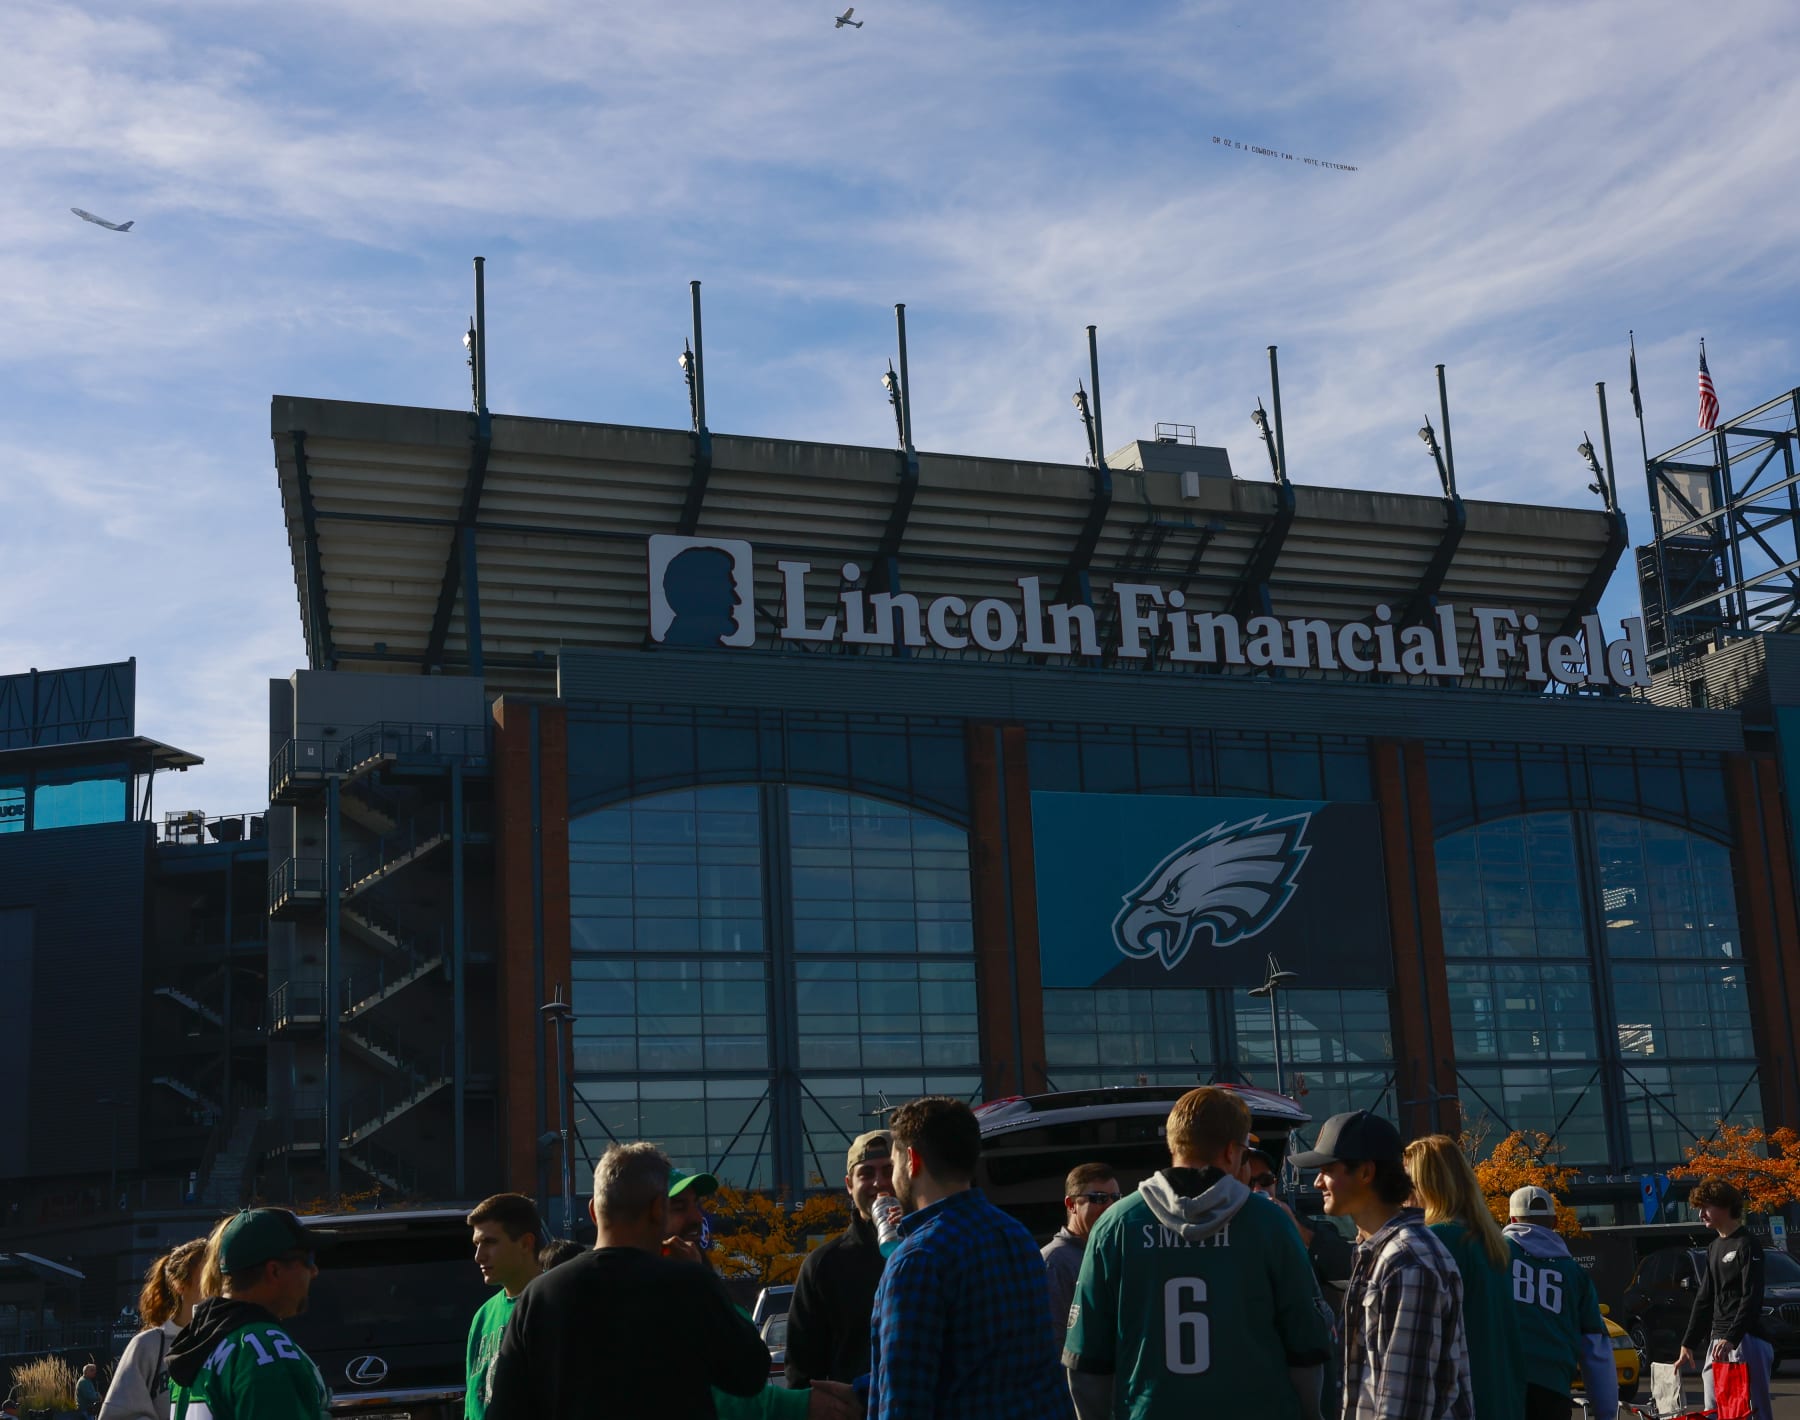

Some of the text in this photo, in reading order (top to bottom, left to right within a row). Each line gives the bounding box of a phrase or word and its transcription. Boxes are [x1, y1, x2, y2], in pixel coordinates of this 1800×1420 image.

[1212, 136, 1221, 144] DR
[1223, 138, 1232, 147] OZ
[1251, 146, 1278, 158] COWBOYS
[1303, 158, 1318, 166] VOTE
[776, 560, 1653, 688] Lincoln Financial Field
[1142, 1223, 1231, 1248] SMH
[1512, 1258, 1563, 1314] 86
[243, 1329, 301, 1366] 12
[1163, 1276, 1211, 1374] 6
